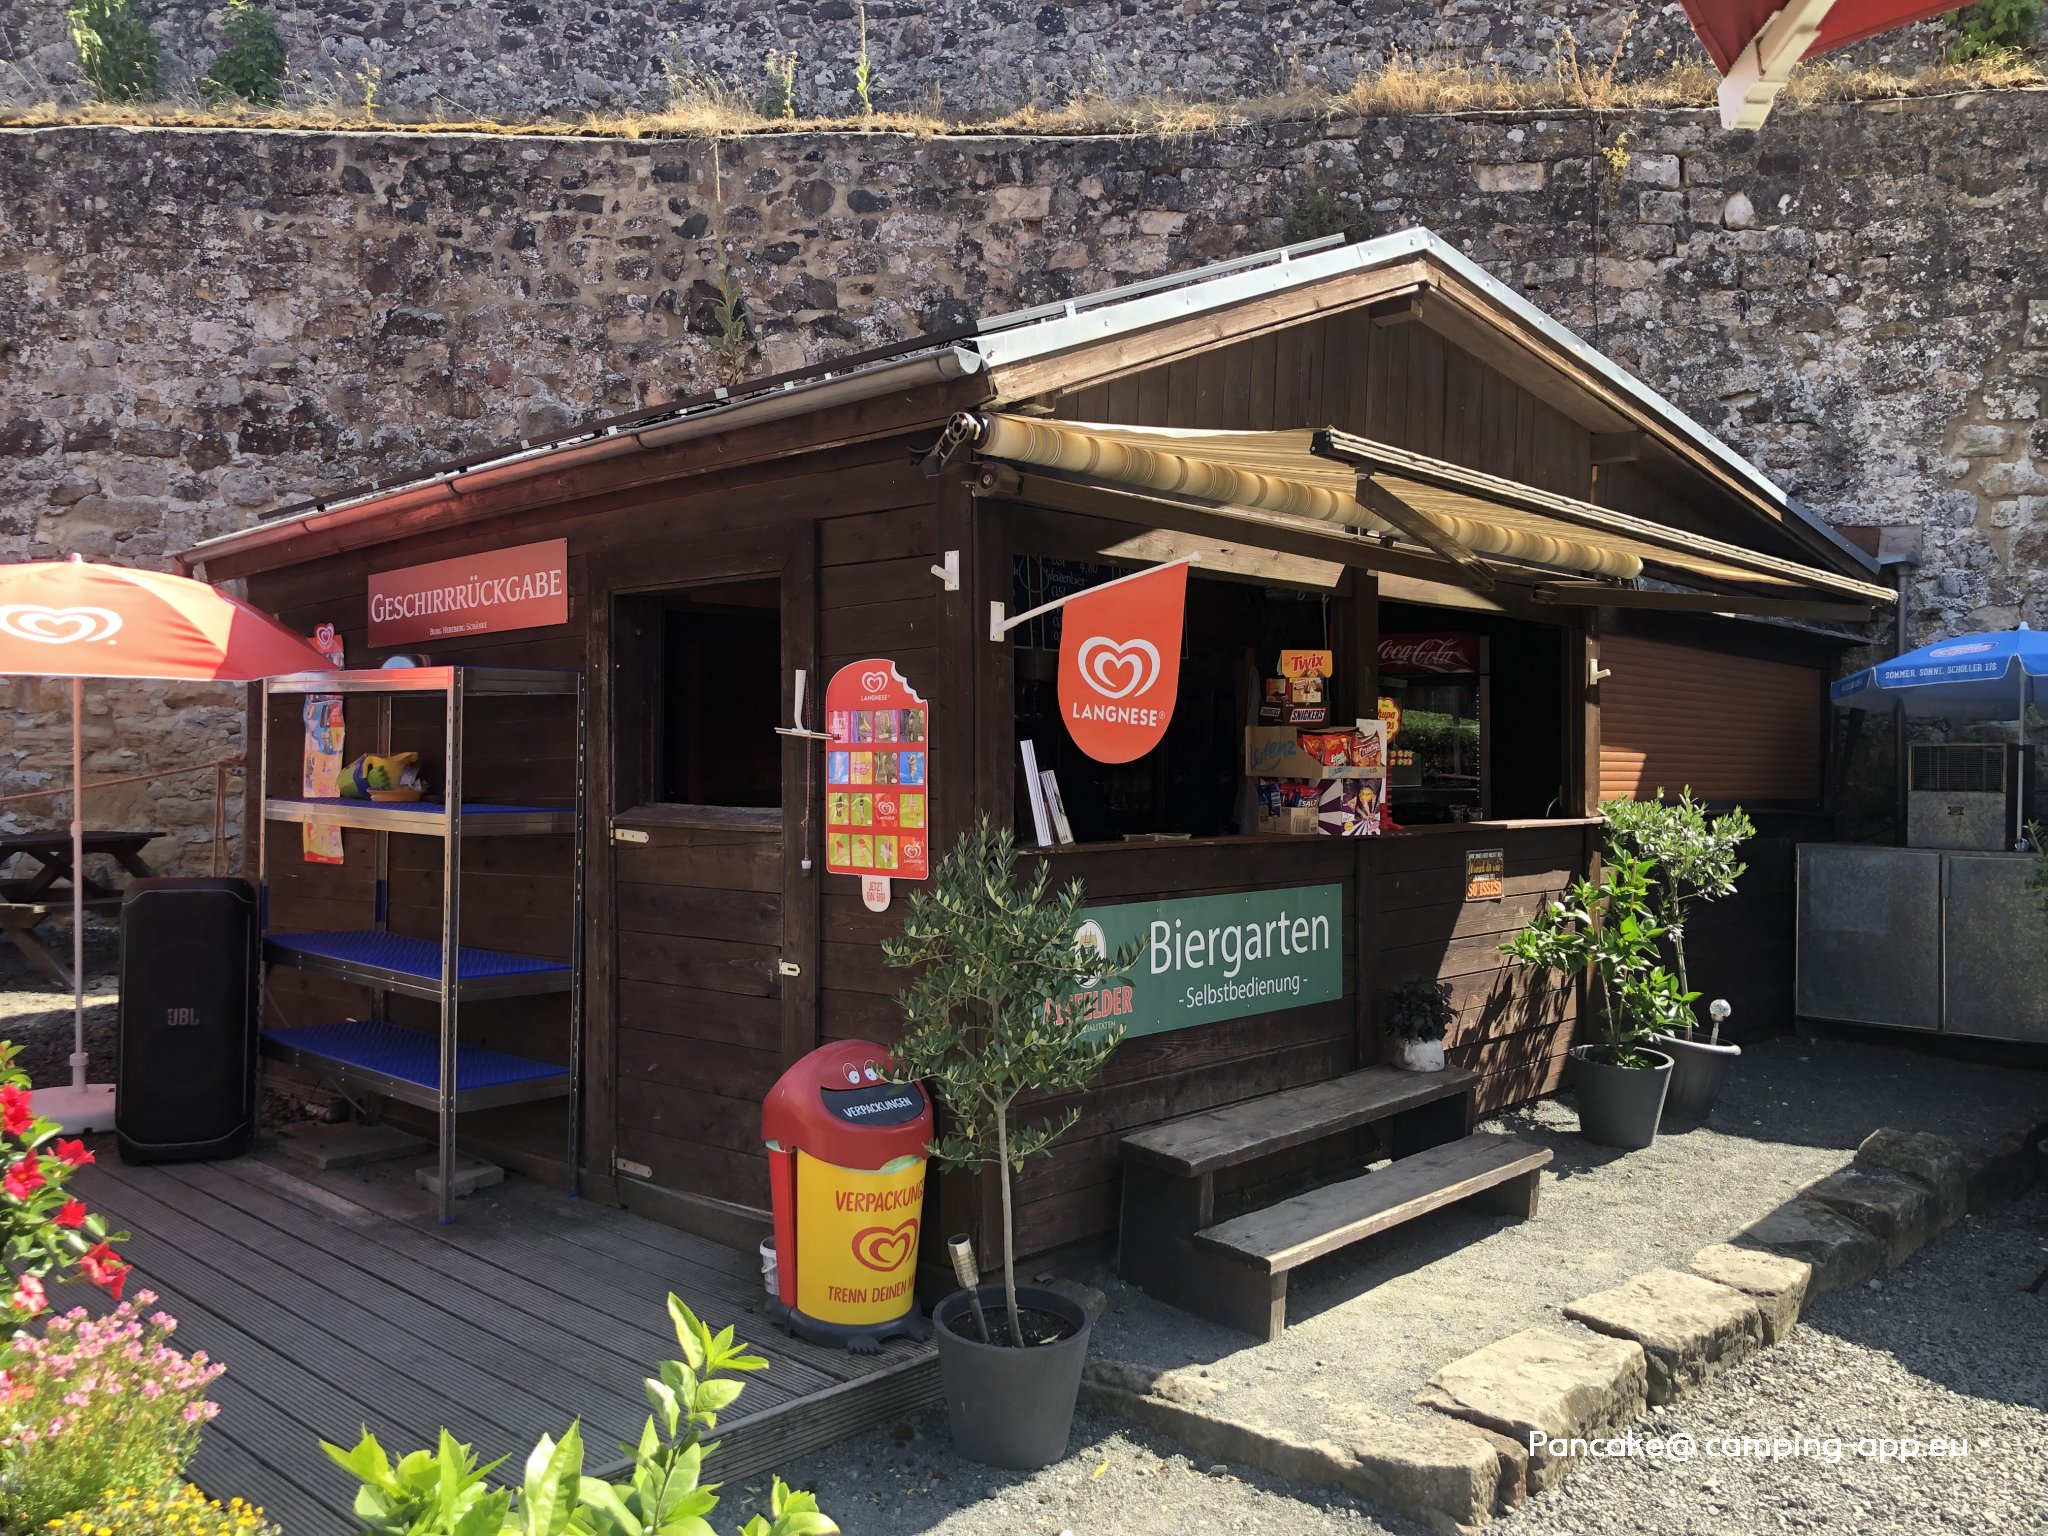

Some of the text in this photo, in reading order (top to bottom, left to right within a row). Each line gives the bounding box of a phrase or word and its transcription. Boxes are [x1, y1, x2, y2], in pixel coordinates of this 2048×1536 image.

[371, 569, 562, 623] GESCHIRRRÜCKGABE
[1291, 653, 1323, 672] Twix
[1292, 709, 1325, 721] SNICKERS
[868, 882, 883, 891] JETZT
[1150, 911, 1329, 978] Biergarten
[168, 1008, 200, 1026] JBL
[843, 1096, 913, 1119] VERPACKUNGEN
[828, 1285, 868, 1304] TRENN
[872, 1279, 907, 1303] DEINEN
